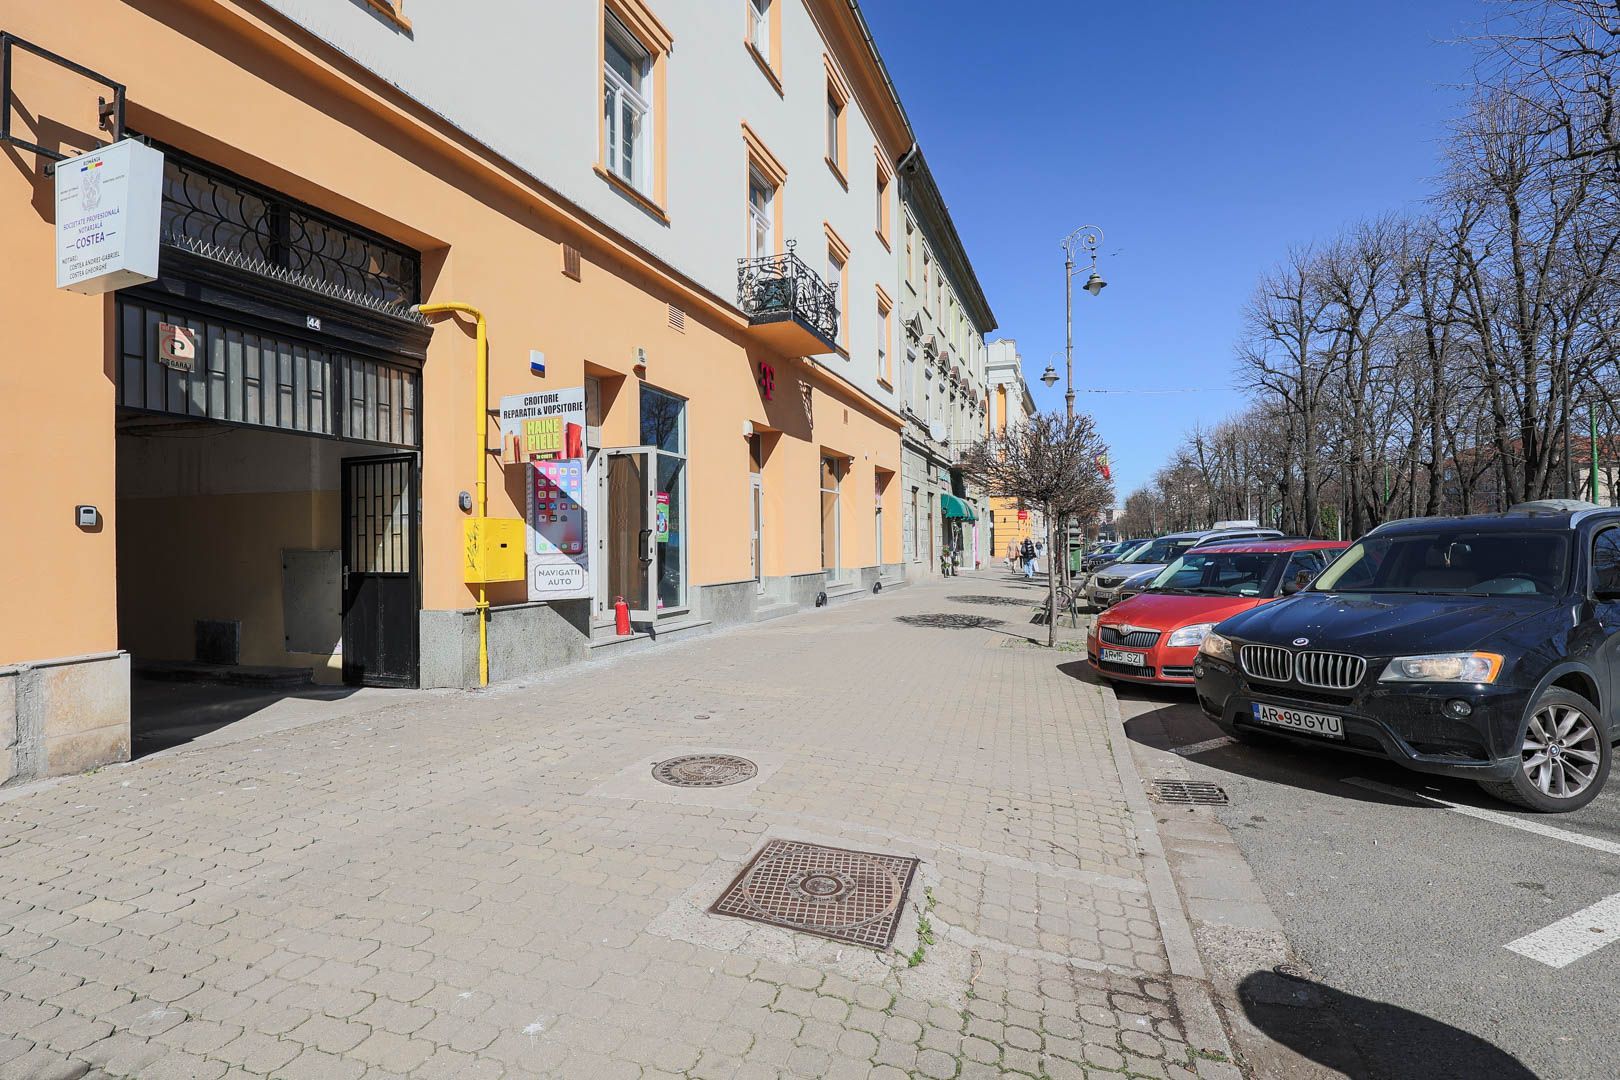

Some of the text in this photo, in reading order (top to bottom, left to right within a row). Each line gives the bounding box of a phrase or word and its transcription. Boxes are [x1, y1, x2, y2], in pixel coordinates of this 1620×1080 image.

[63, 217, 86, 231] SOCIETATE
[76, 232, 105, 249] COSTEA
[69, 262, 85, 272] COSTEA
[69, 263, 108, 280] COSTEA GHEORGHE
[309, 317, 321, 329] 44
[524, 393, 559, 406] CROITORIE
[537, 408, 543, 416] &
[543, 401, 583, 415] VOPSITORIE
[527, 418, 560, 435] HAINE
[527, 432, 560, 452] PIELE
[1304, 714, 1340, 733] GYU
